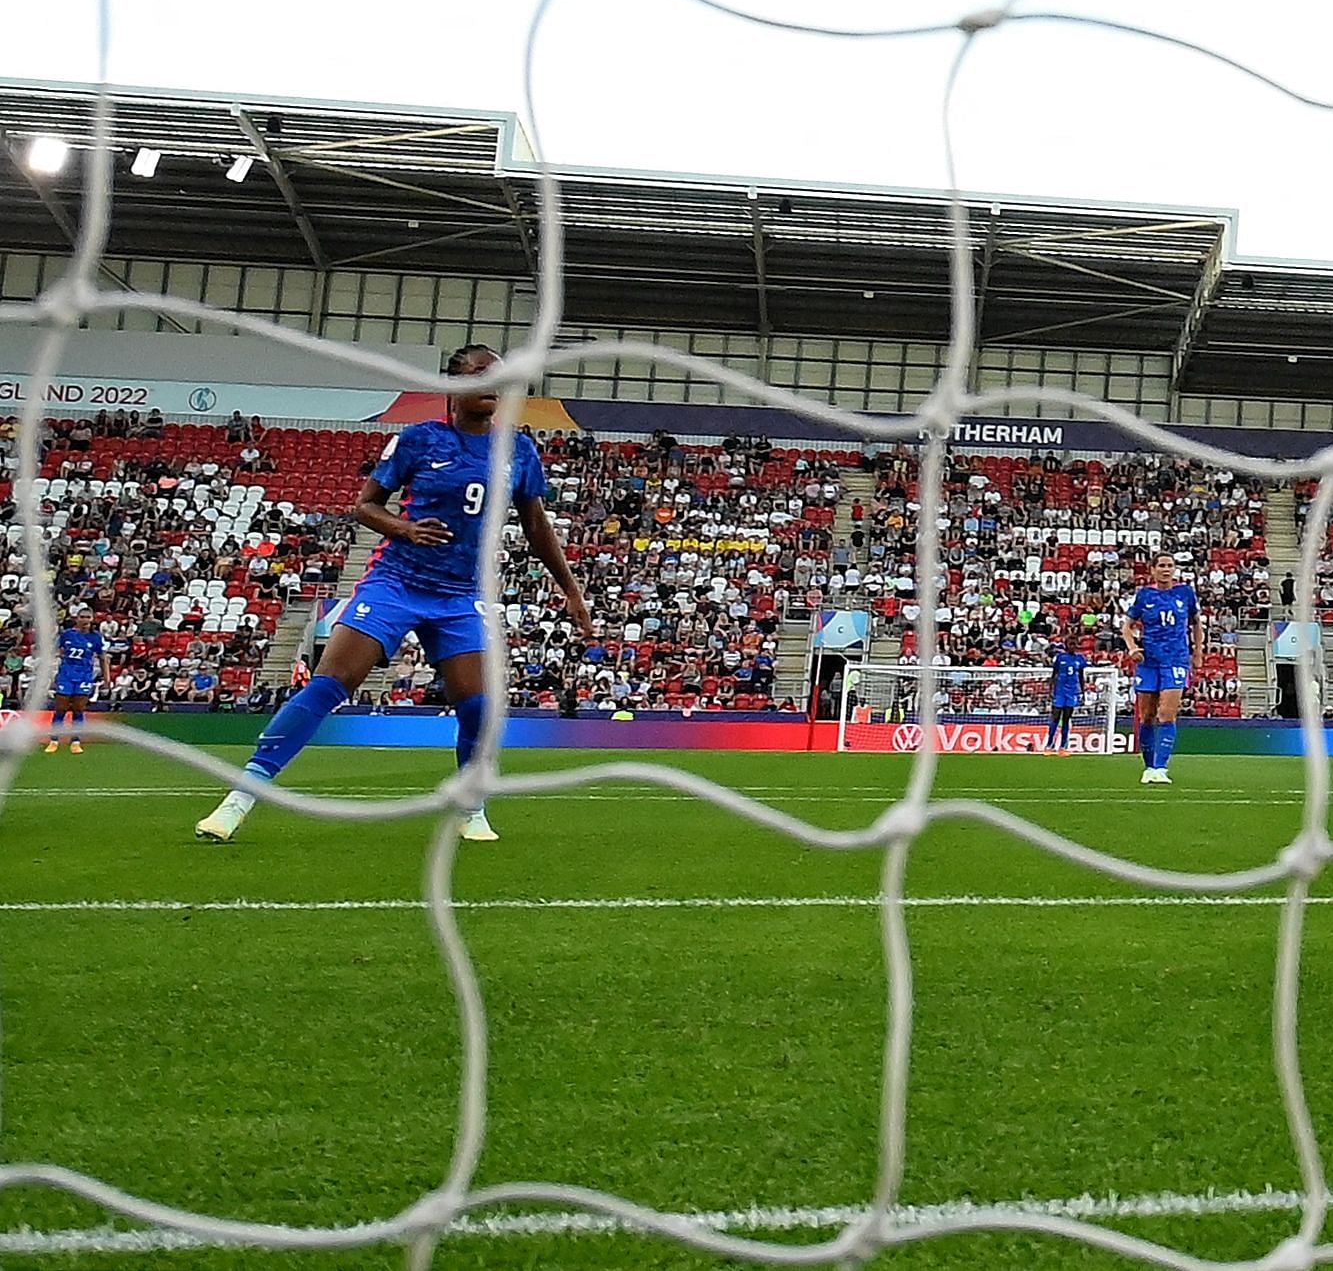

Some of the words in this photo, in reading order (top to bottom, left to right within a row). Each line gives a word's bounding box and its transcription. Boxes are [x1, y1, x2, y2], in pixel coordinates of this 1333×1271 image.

[90, 386, 148, 405] 2022
[464, 483, 486, 515] 9
[69, 647, 84, 659] 22
